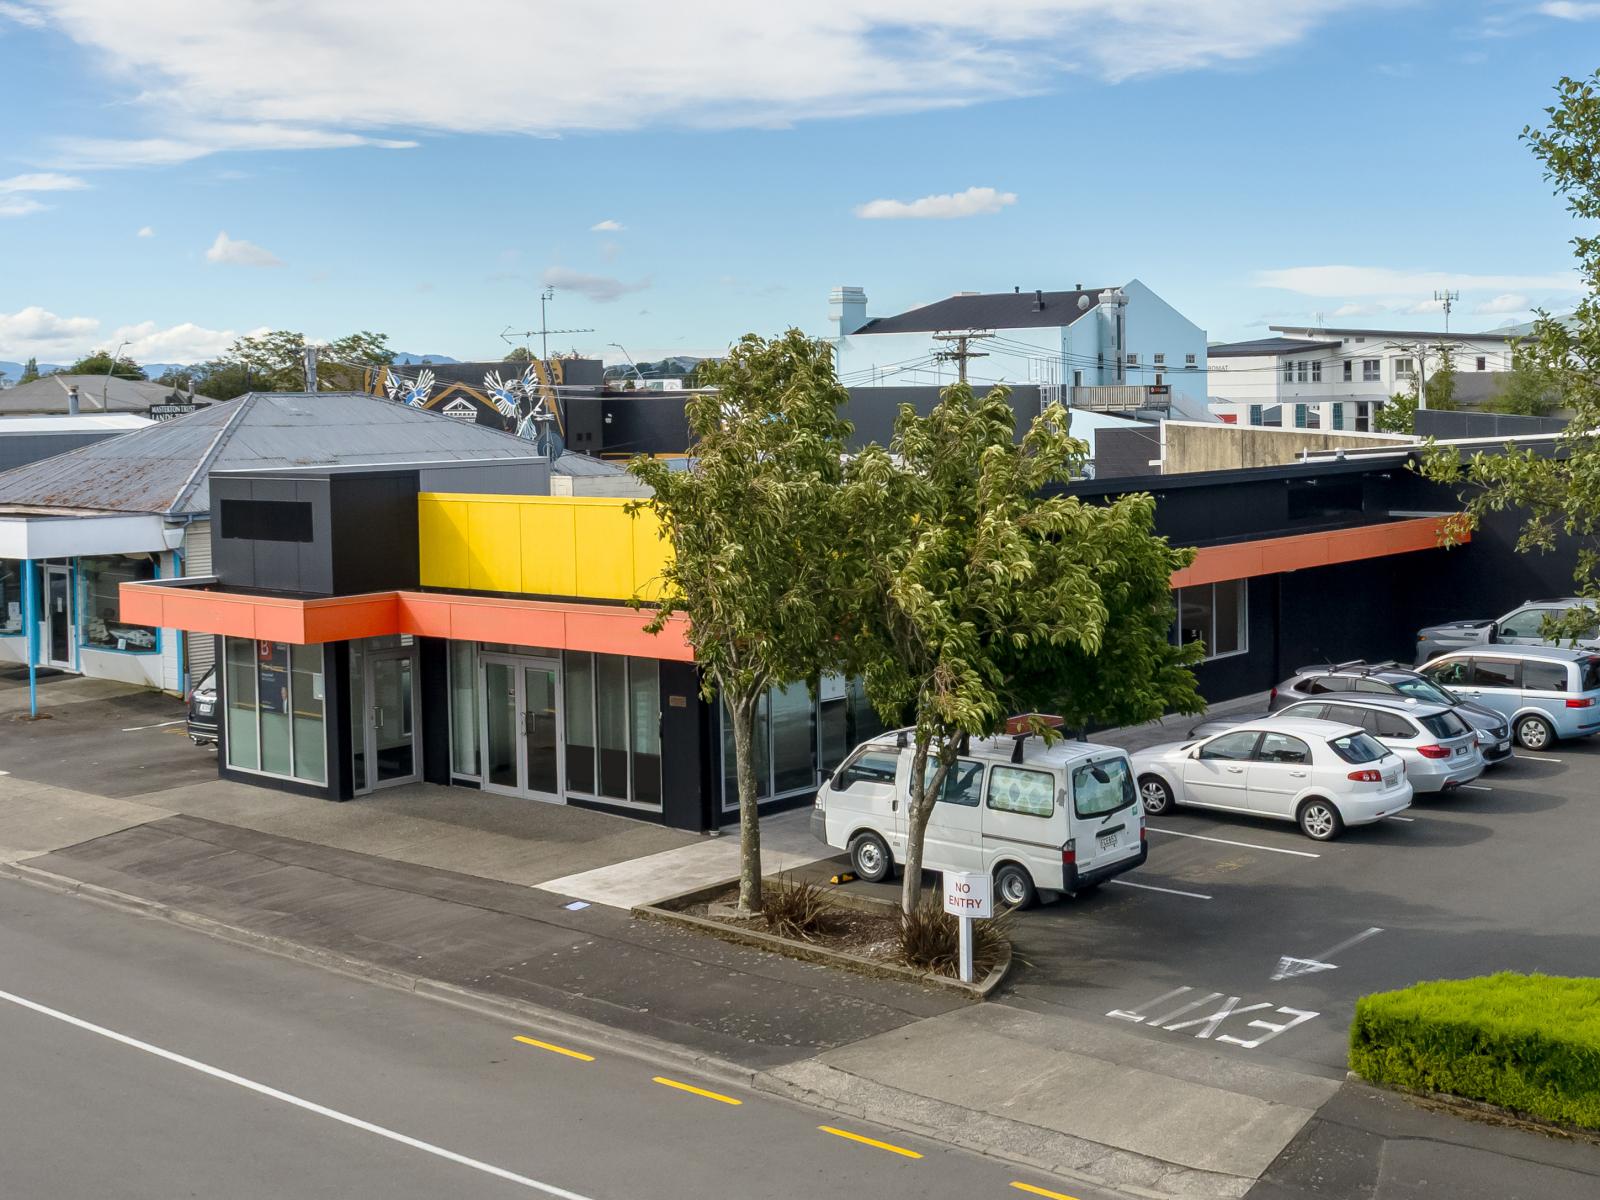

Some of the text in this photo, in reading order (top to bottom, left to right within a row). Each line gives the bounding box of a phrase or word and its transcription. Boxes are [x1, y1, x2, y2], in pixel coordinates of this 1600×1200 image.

[955, 882, 971, 894] NO
[948, 895, 983, 909] ENTRY
[1105, 985, 1321, 1049] EXIT
